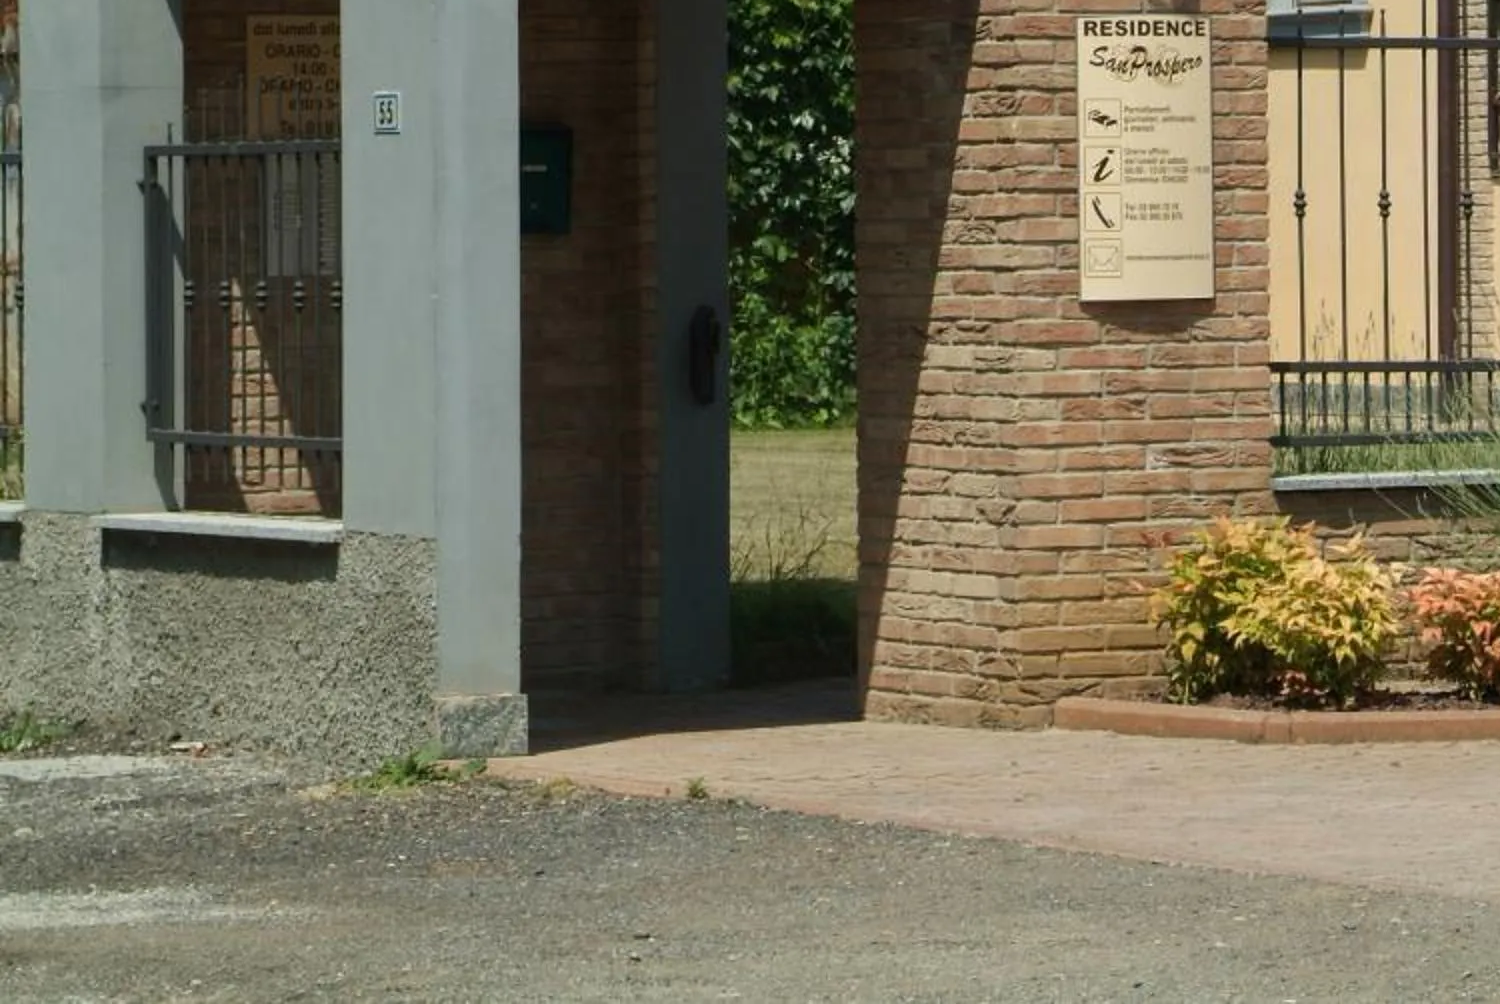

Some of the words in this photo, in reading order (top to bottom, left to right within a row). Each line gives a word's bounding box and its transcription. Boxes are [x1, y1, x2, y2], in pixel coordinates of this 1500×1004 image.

[1083, 19, 1207, 37] RESIDENCE
[264, 43, 321, 59] ORARIO
[379, 99, 393, 125] 55
